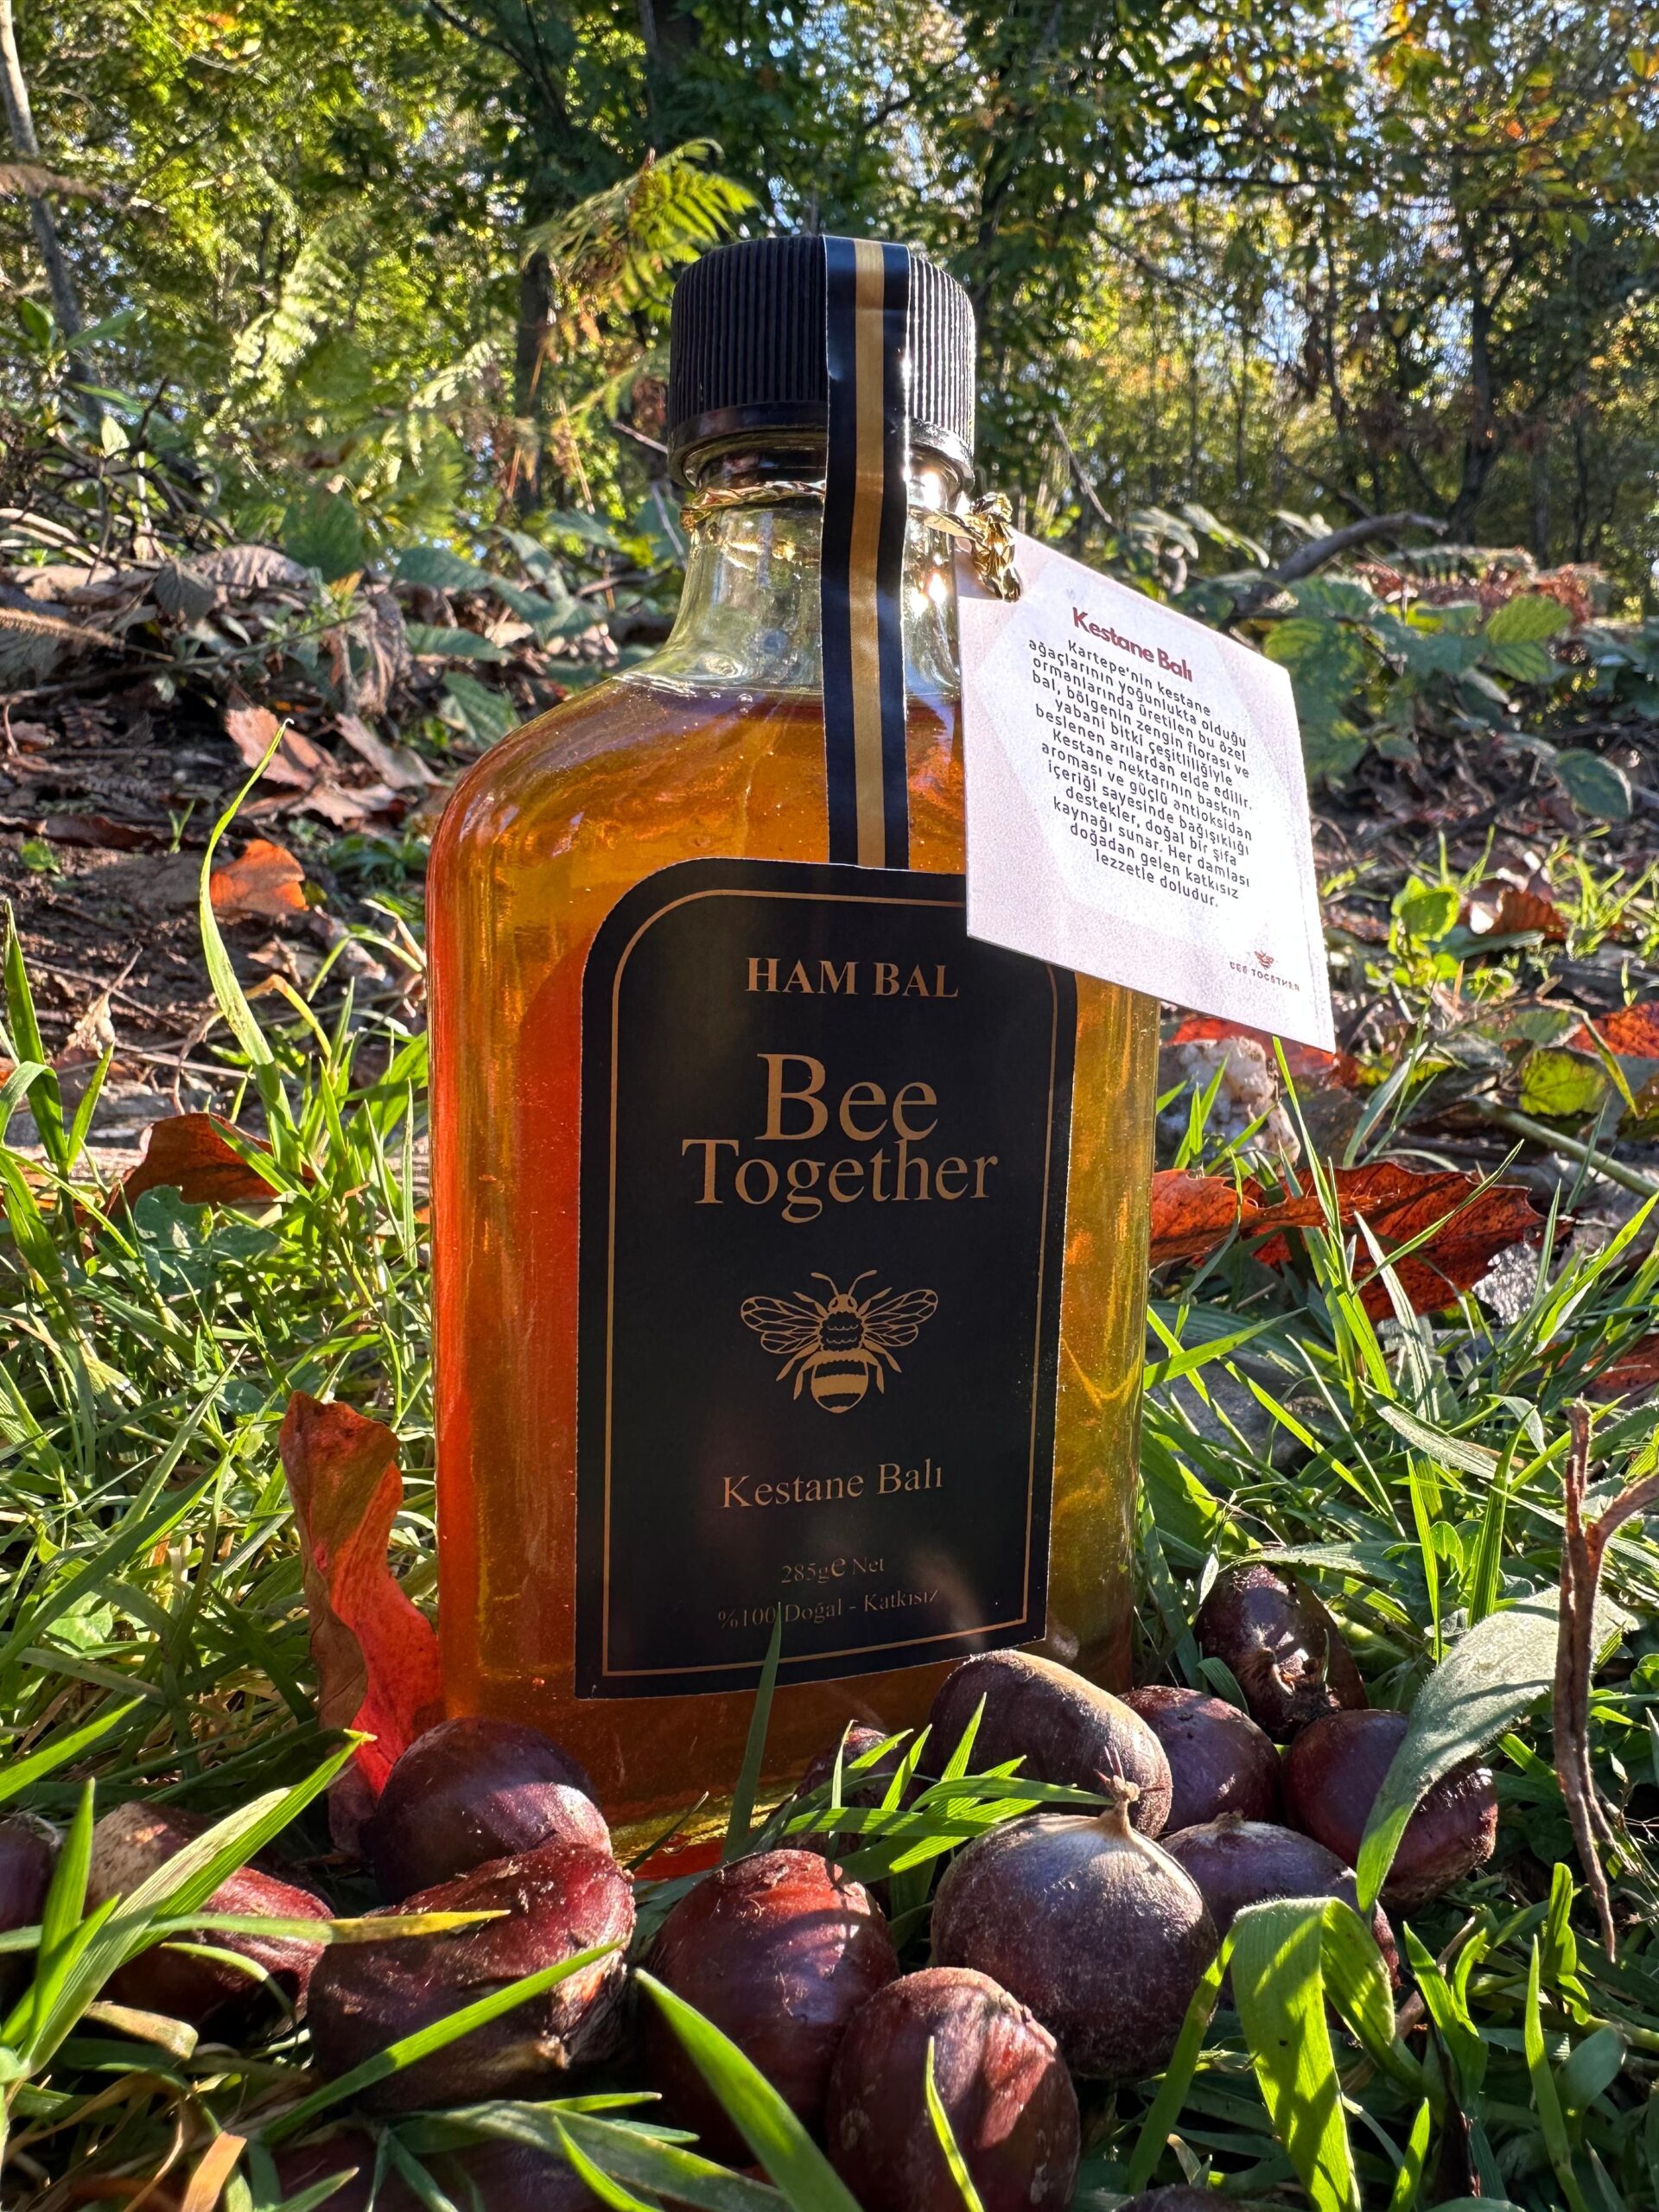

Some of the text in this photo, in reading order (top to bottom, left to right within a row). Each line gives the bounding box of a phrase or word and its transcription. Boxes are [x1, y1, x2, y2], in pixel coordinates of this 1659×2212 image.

[1068, 639, 1211, 716] Kartepe'nin kestane
[1072, 607, 1192, 683] Kestane Balı
[1029, 639, 1246, 747] ağaçlarının yoğunlukta olduğu
[1033, 658, 1246, 762] ormanlarında üretilen bu özel
[1033, 670, 1249, 779] bal, bölgenin zengin florası ve
[1055, 699, 1105, 729] yabani
[1111, 721, 1143, 747] bitki
[1036, 703, 1252, 810] beslenen arılardan elde edilir.
[1042, 743, 1252, 841] aroması ve güçlü antioksidan
[1048, 760, 1096, 791] içeriği
[1103, 785, 1173, 823] sayesinde
[1053, 728, 1240, 821] Kestane nektarının baskın
[1053, 796, 1249, 887] kaynağı sunar. Her damlası
[1071, 823, 1239, 899] doğadan gelen katkısız
[1096, 849, 1218, 908] lezzetle doludur.
[1146, 819, 1184, 844] doğal
[1190, 836, 1207, 854] bir
[1213, 849, 1236, 866] şifa
[746, 957, 958, 998] HAM BAL
[755, 1053, 938, 1142] Bee
[682, 1137, 999, 1224] Together
[722, 1458, 943, 1509] Kestane Balı
[852, 1557, 885, 1575] Net
[718, 1606, 777, 1630] %100
[785, 1599, 842, 1624] Doğal
